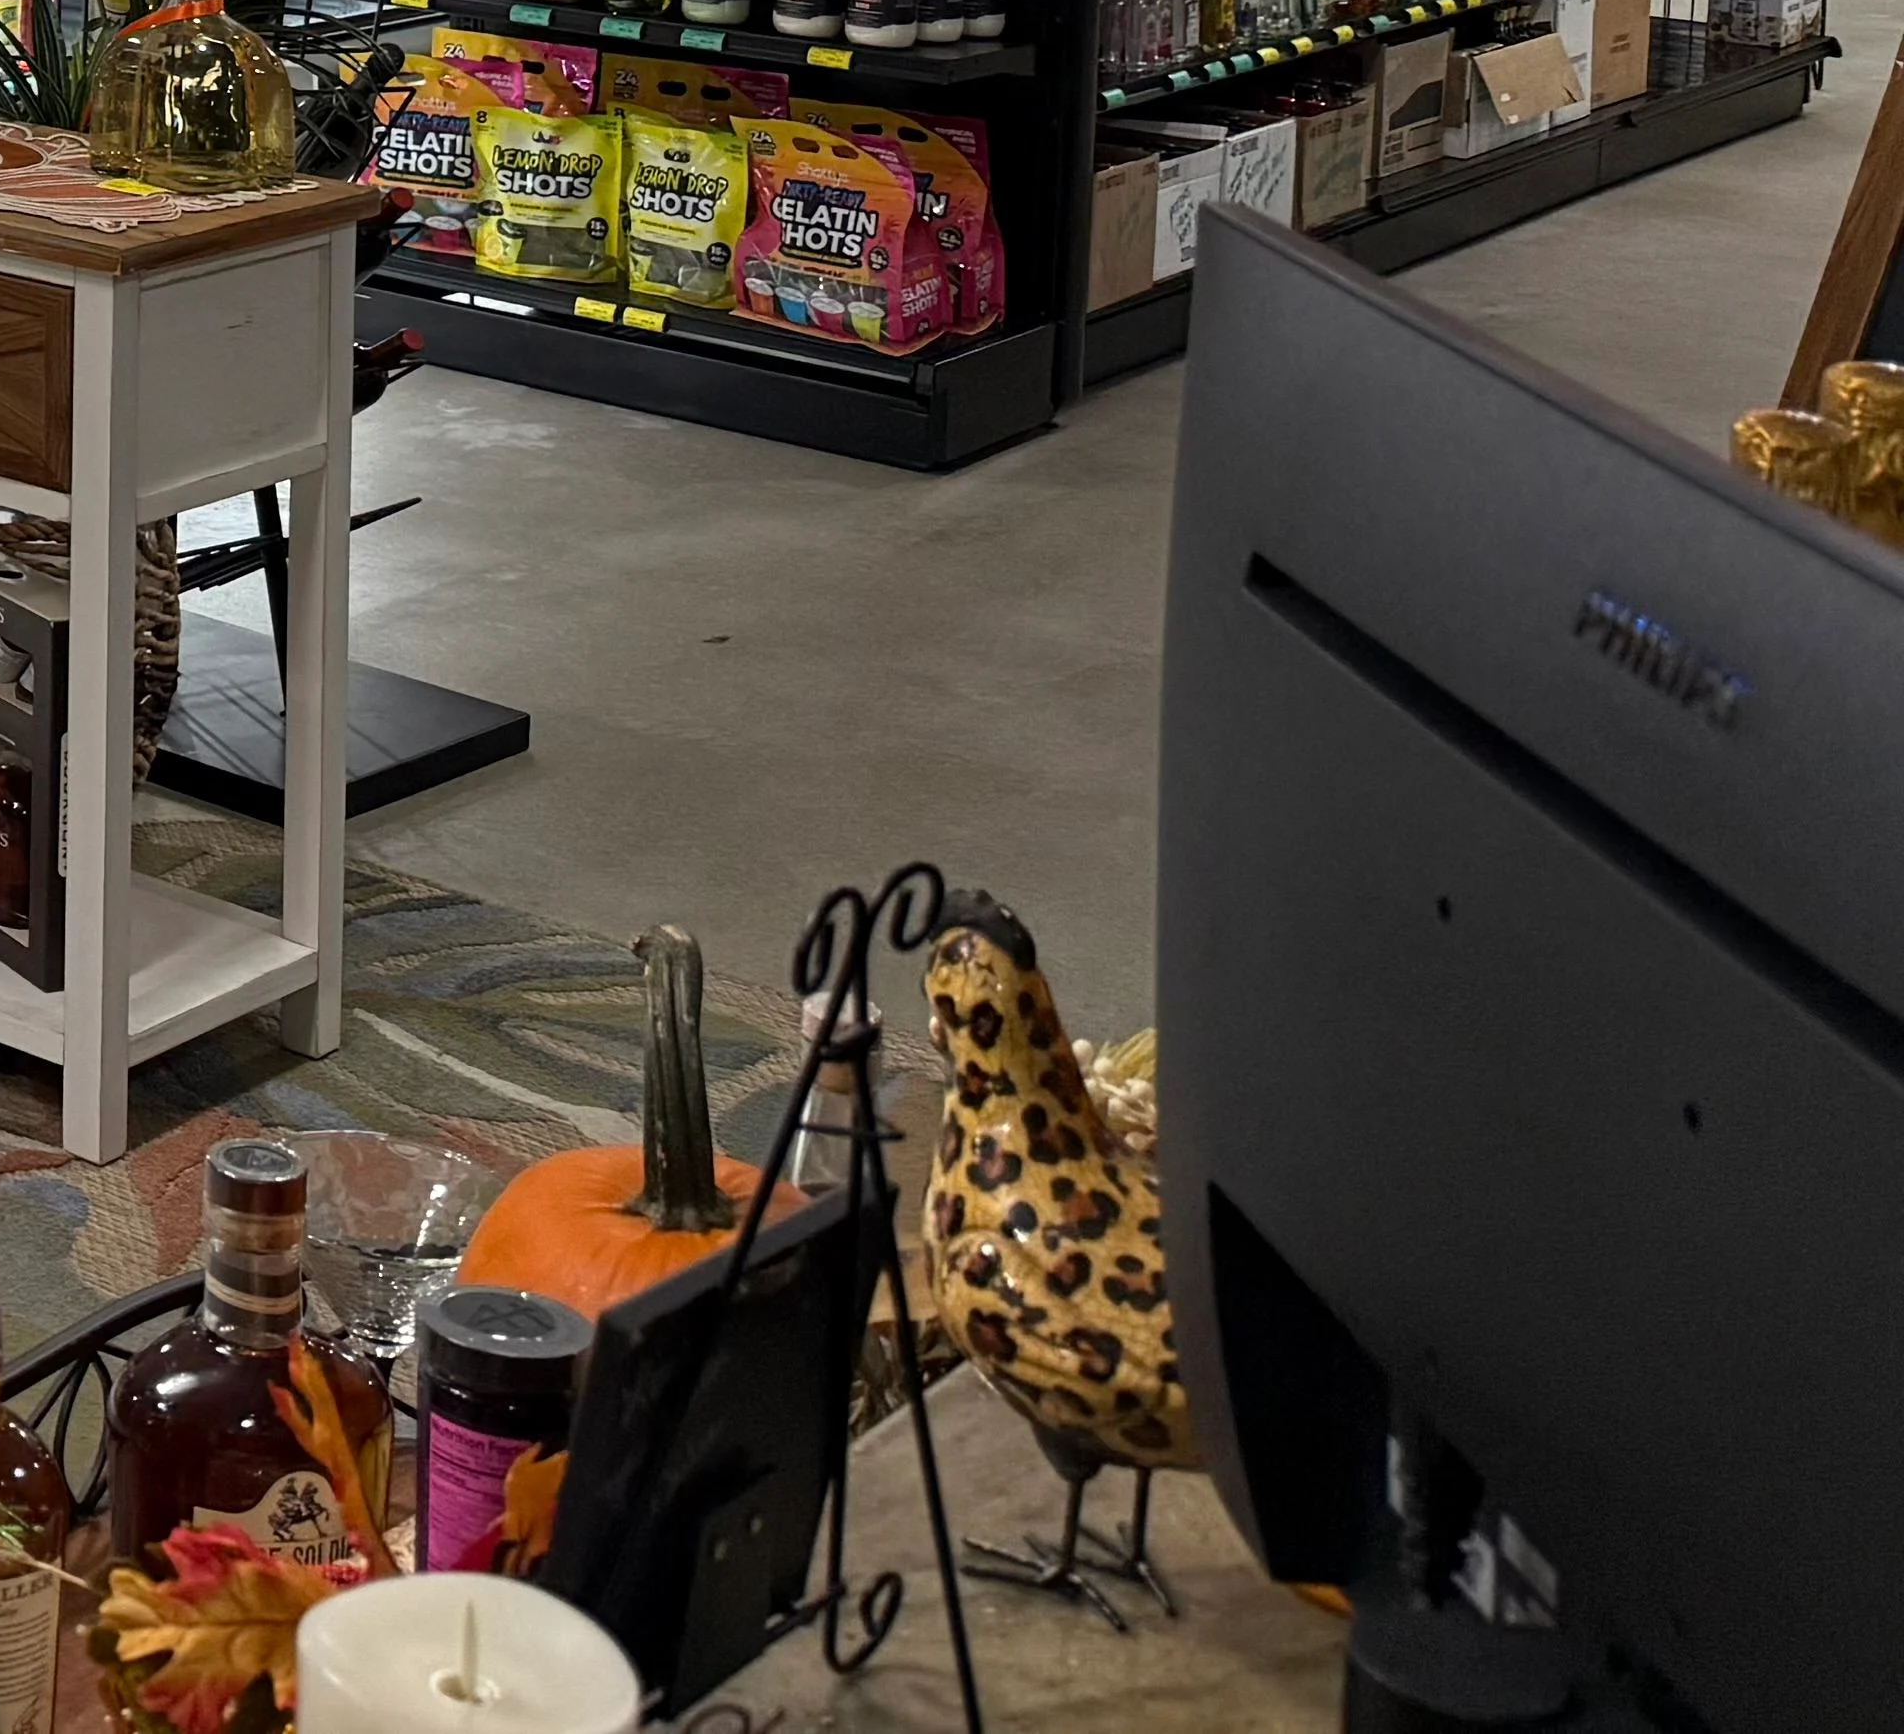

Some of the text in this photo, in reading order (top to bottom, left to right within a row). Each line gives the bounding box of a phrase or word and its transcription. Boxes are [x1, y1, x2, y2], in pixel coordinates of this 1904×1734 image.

[444, 45, 464, 57] 24
[476, 110, 488, 124] 8
[752, 131, 772, 143] 24
[379, 148, 472, 178] SHOTS
[492, 146, 602, 175] LEMON DROP
[496, 171, 591, 197] SHOTS
[635, 163, 726, 199] LEMON DROP
[631, 191, 716, 220] SHOTS
[772, 197, 877, 236] GELATIN
[901, 294, 939, 317] SHOTS
